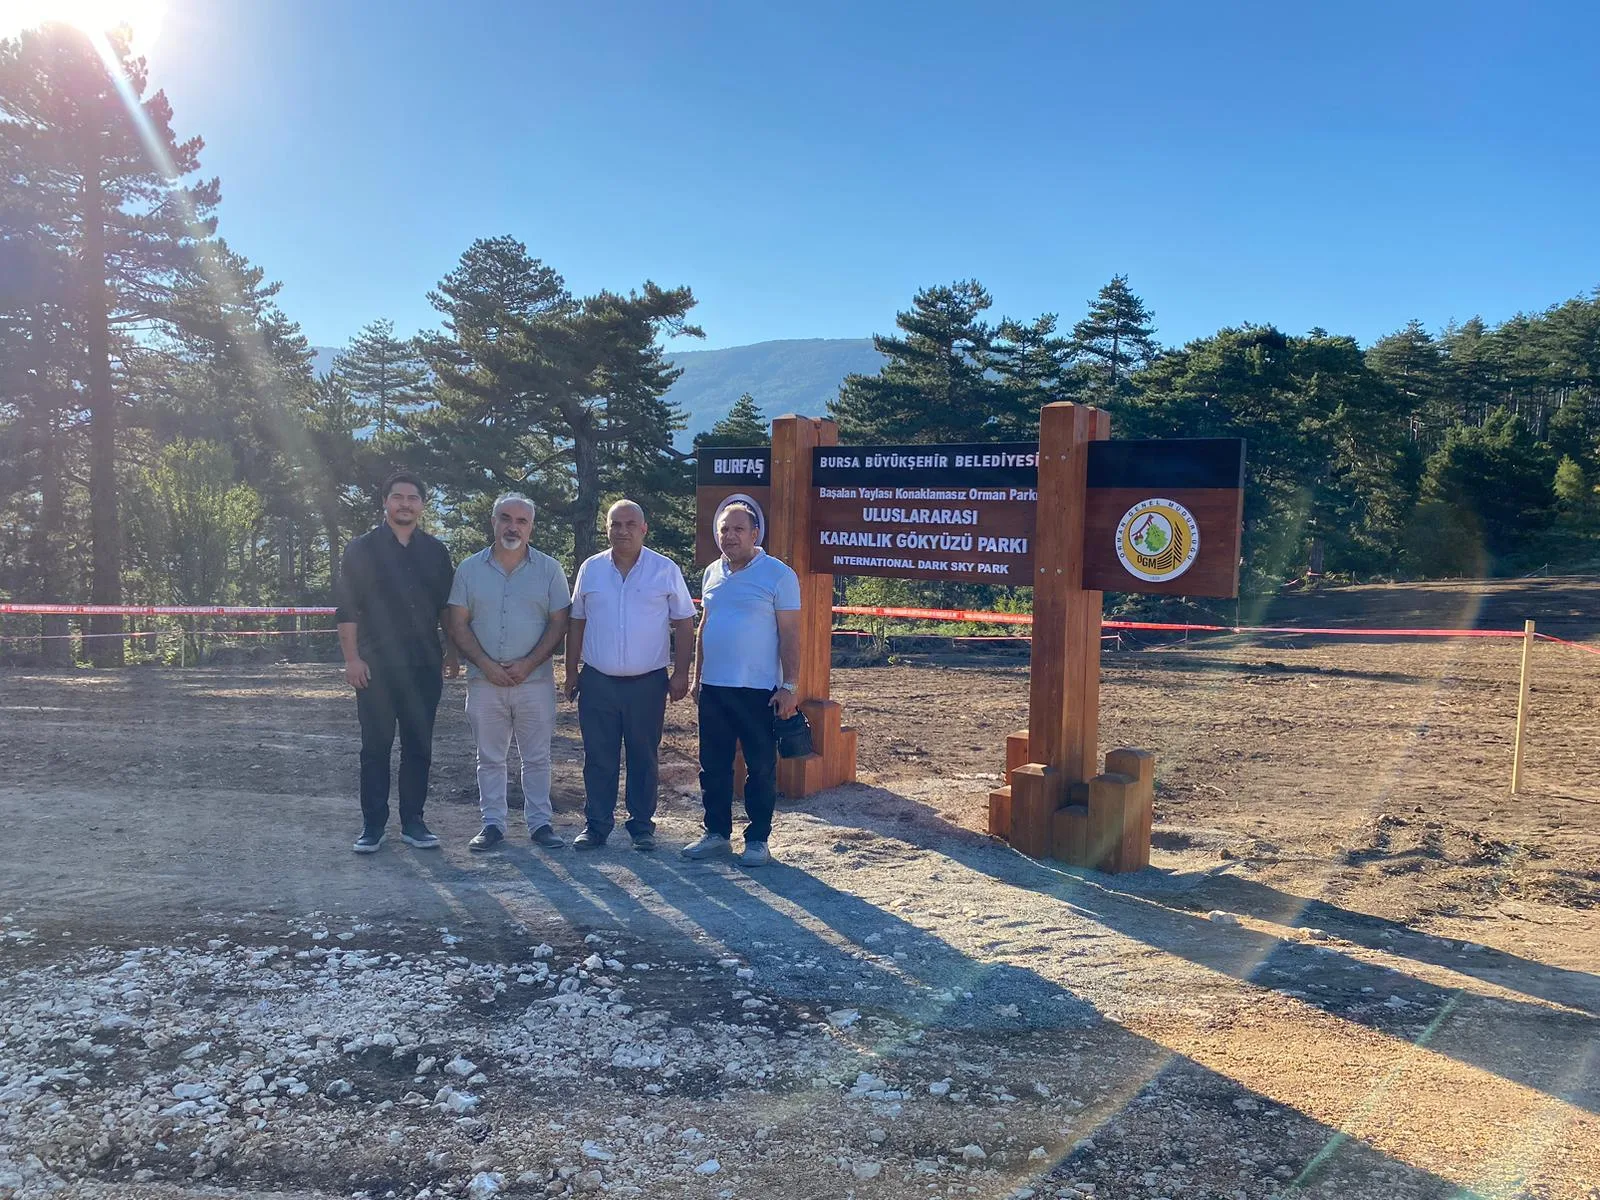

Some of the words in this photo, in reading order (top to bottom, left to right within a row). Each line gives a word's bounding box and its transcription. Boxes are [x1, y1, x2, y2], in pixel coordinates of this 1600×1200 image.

[714, 459, 764, 478] BURFAŞ
[820, 456, 860, 468] BURSA
[865, 453, 948, 470] BÜYÜKŞEHİR
[955, 452, 1040, 468] BELEDİYESİ
[819, 487, 857, 501] Başalan
[858, 488, 893, 502] Yaylası
[895, 488, 966, 500] Konaklamasız
[969, 488, 1006, 500] Orman
[863, 507, 978, 525] ULUSLARARASI
[1128, 500, 1161, 518] GENEL
[820, 531, 893, 548] KARANLIK
[896, 532, 973, 551] GÖKYÜZÜ
[977, 537, 1028, 554] PARKI
[833, 555, 916, 569] INTERNATIONAL
[917, 559, 949, 571] DARK
[951, 562, 975, 573] SKY
[977, 563, 1009, 574] PARK
[1137, 555, 1157, 569] OGM
